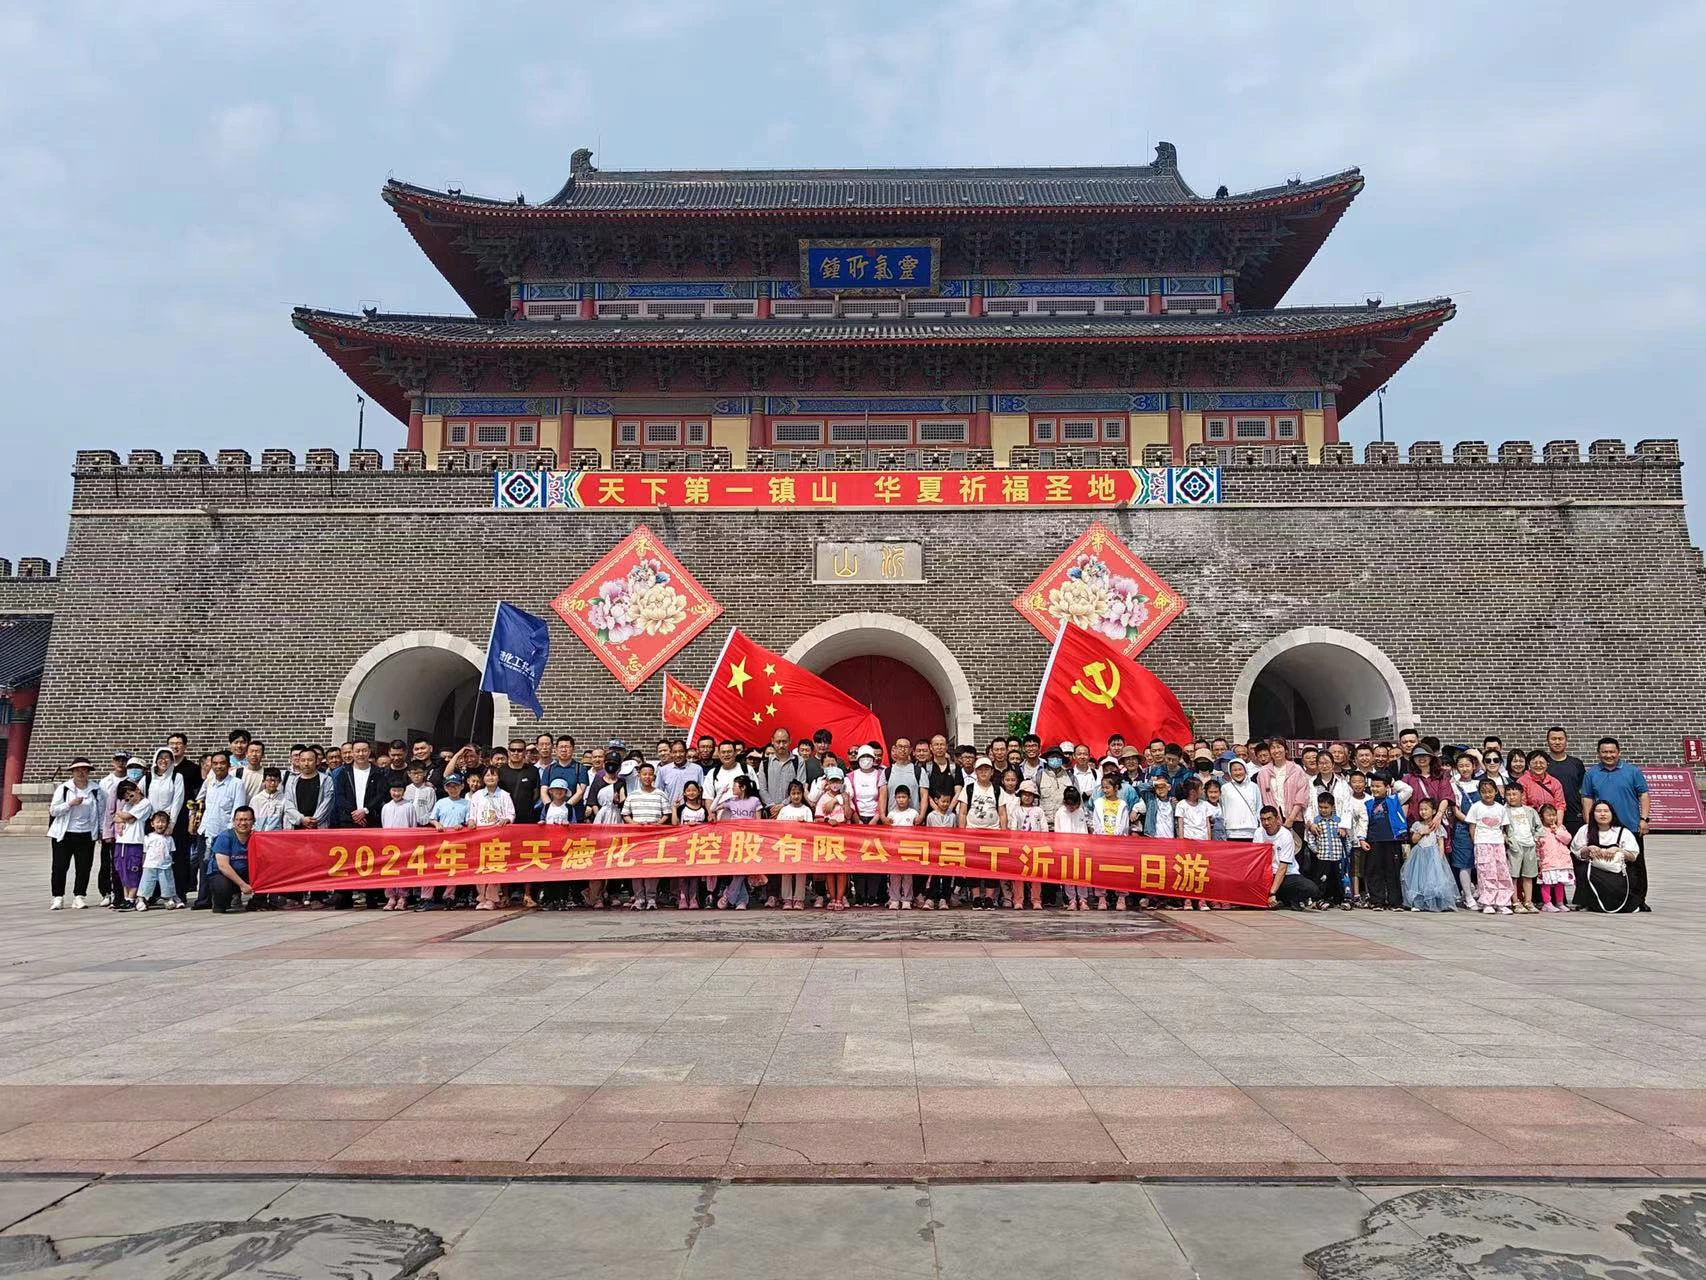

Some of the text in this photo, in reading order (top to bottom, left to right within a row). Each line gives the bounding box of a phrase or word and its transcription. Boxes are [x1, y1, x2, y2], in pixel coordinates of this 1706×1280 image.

[598, 474, 1116, 504] 天下第一镇山 华夏祈福圣地
